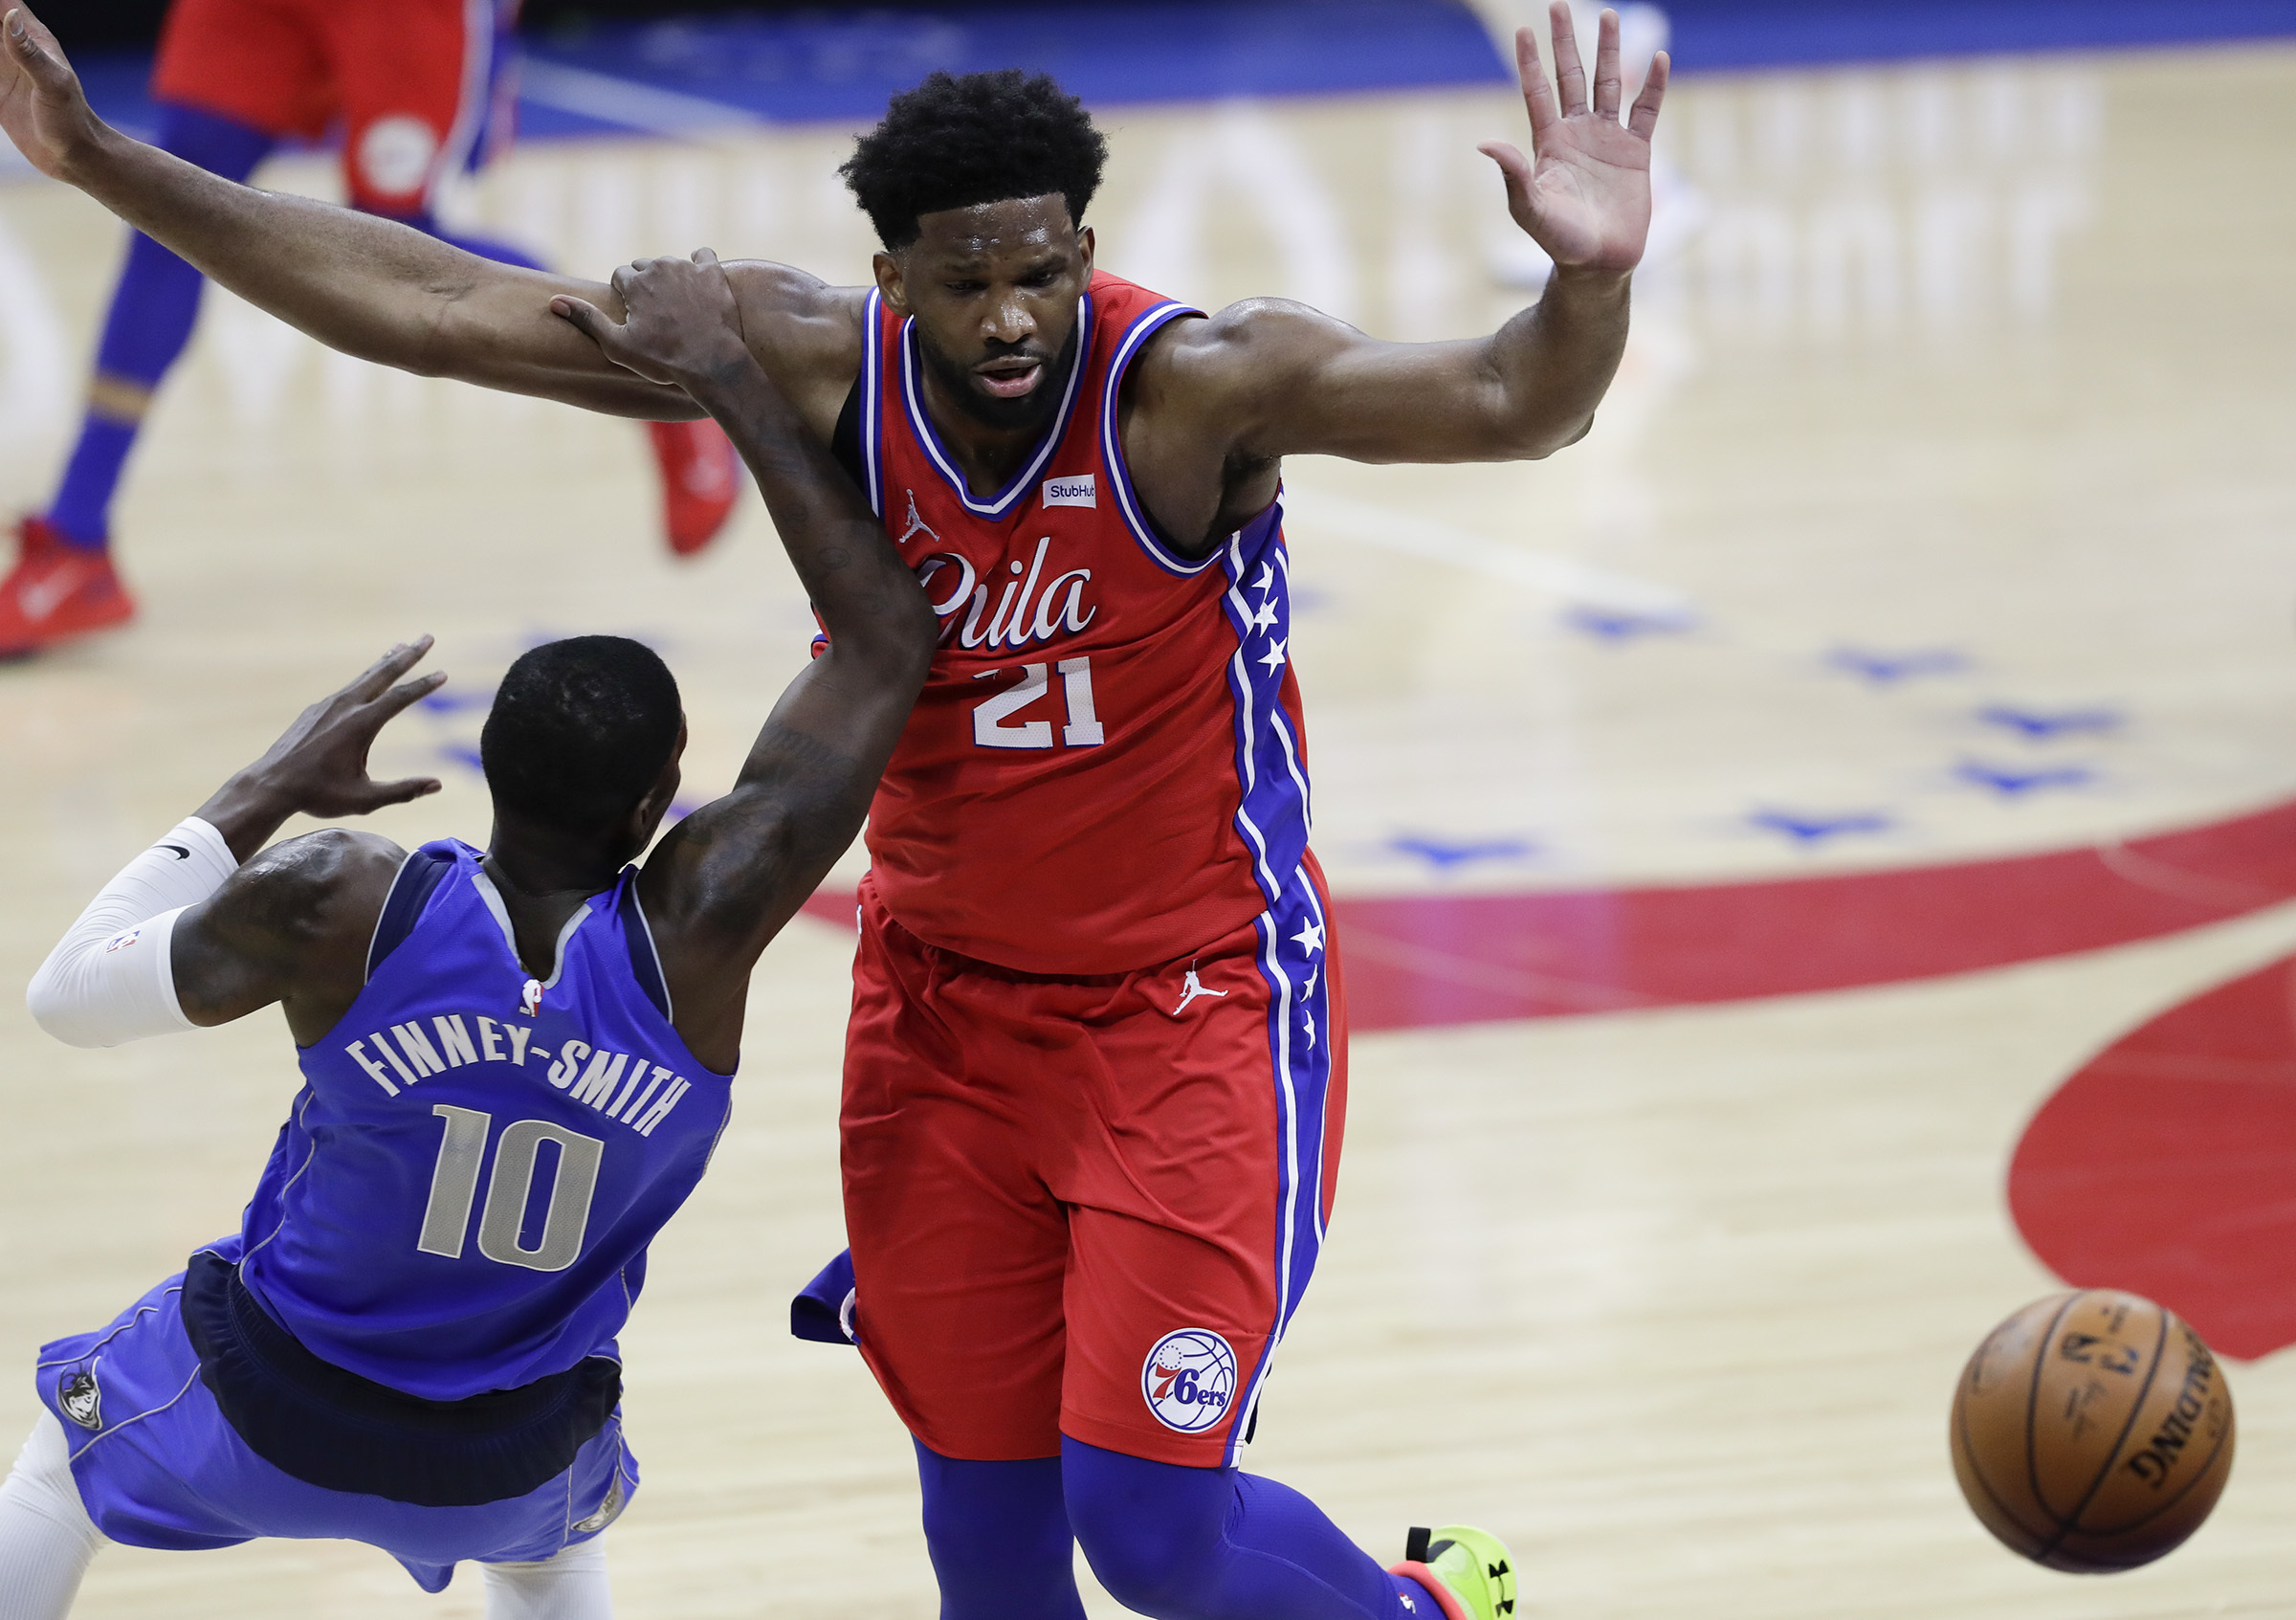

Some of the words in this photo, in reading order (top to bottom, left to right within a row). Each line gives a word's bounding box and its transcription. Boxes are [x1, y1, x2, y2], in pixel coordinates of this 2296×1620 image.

[972, 655, 1105, 749] 21
[344, 1013, 692, 1138] FINNEY-SMITH
[416, 1103, 605, 1272] 10
[1152, 1362, 1226, 1407] 76ers
